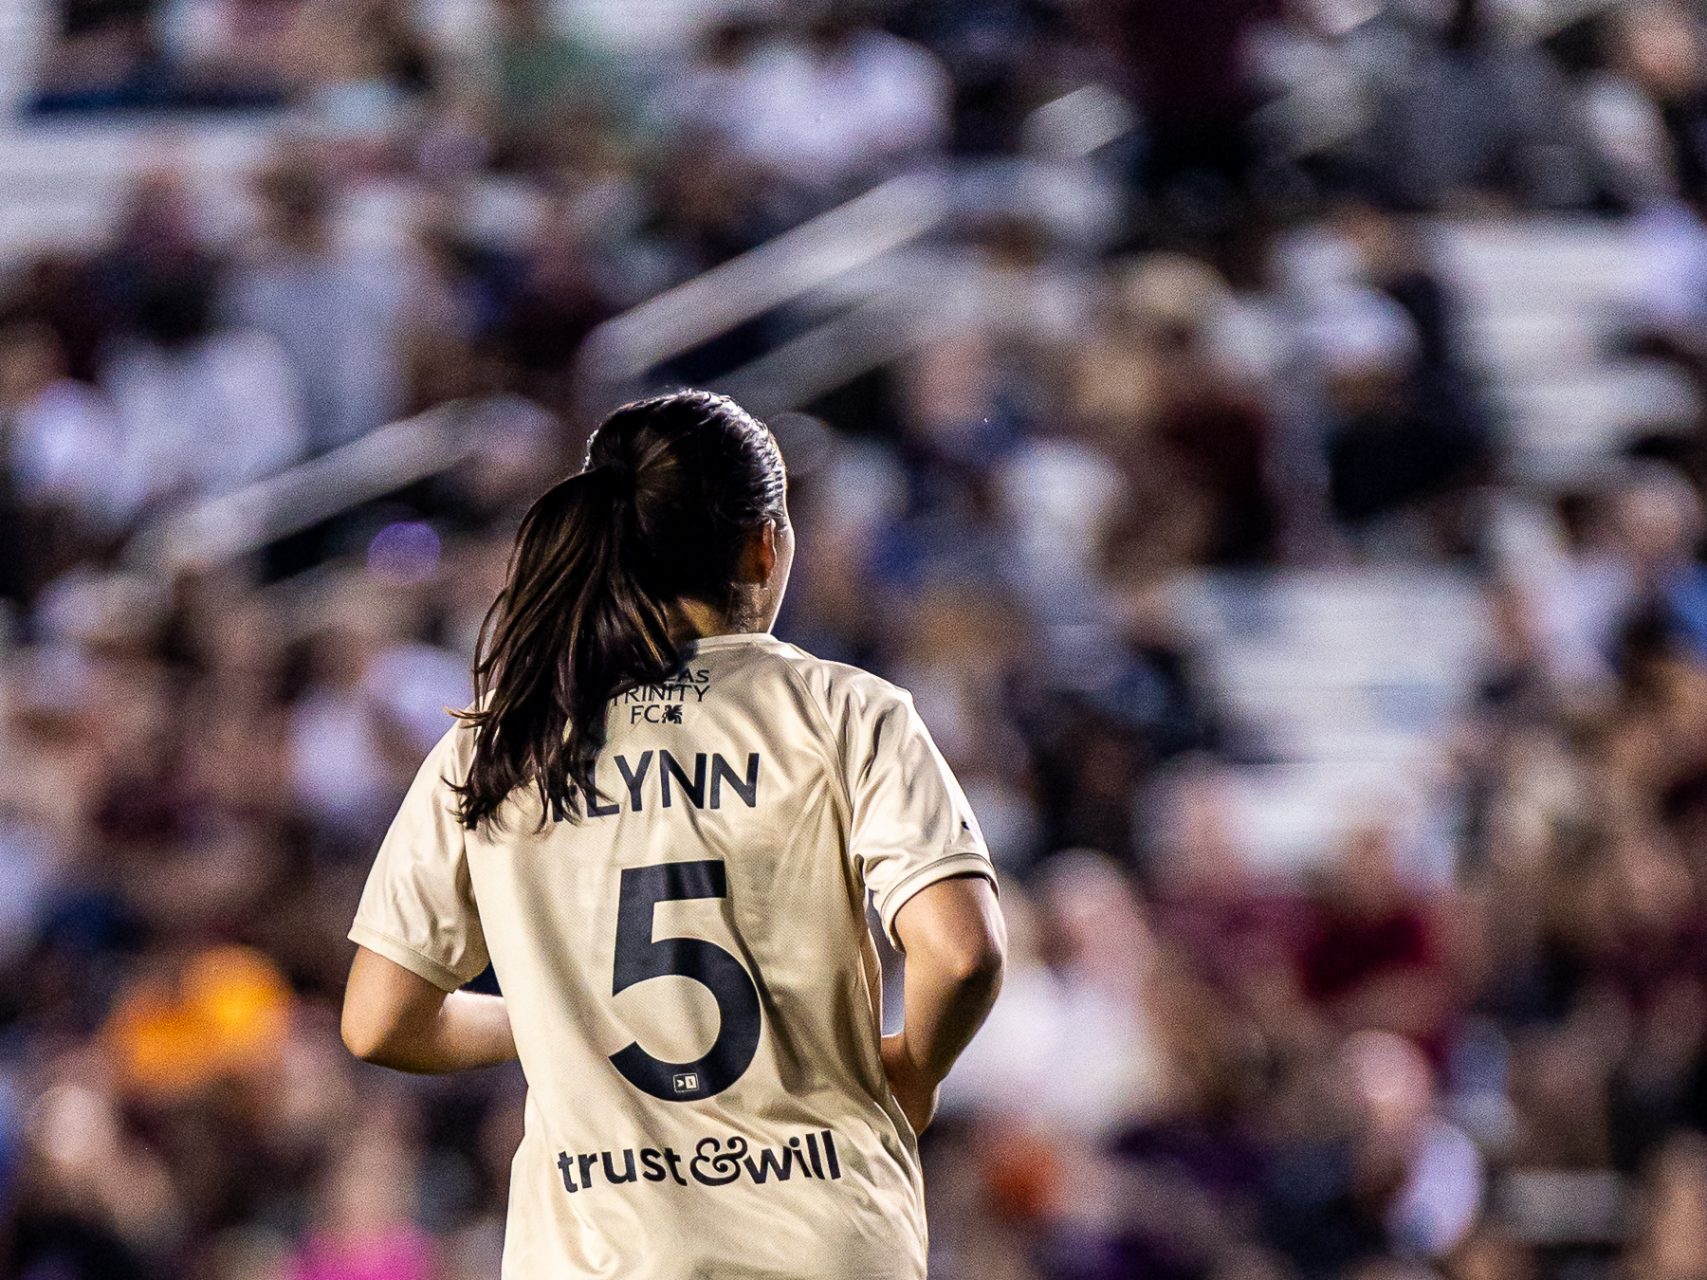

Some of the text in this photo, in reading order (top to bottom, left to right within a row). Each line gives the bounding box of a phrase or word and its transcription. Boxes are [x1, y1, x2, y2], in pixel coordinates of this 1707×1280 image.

[630, 705, 661, 724] FC
[608, 859, 762, 1102] 5
[557, 1130, 842, 1193] trust&will
